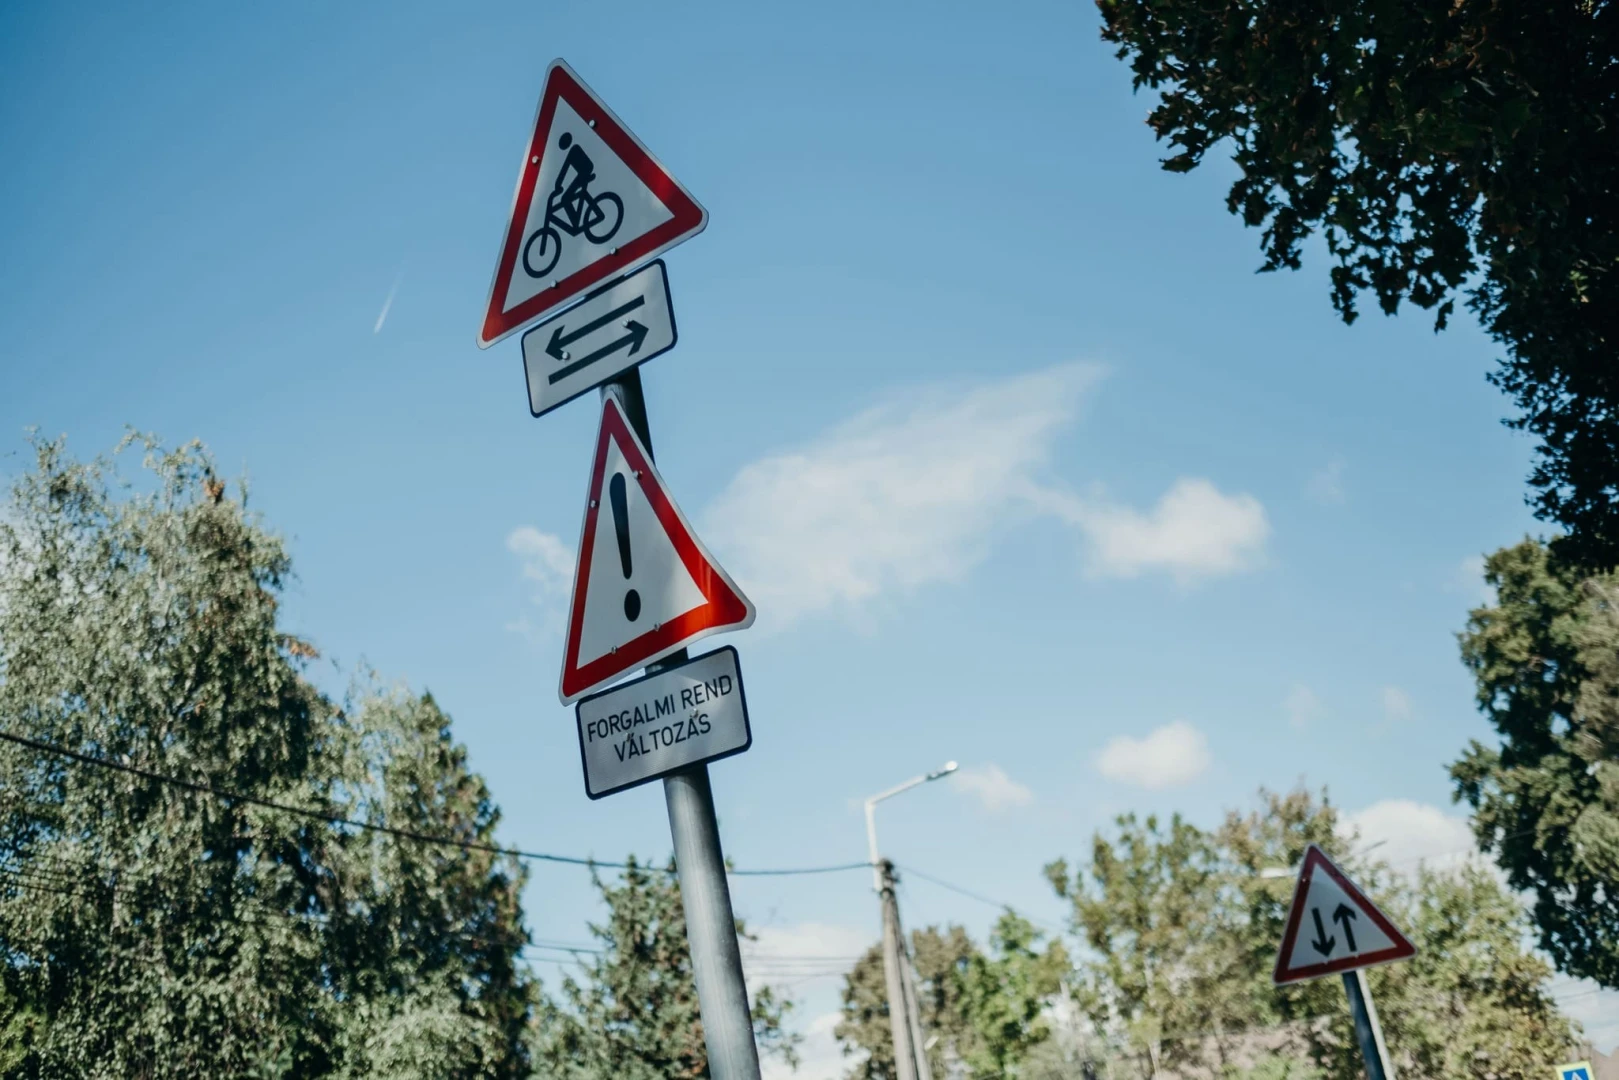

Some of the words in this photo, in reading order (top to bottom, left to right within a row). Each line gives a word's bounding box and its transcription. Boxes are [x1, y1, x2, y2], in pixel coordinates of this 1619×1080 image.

[587, 694, 675, 742] FORGALMI
[681, 675, 732, 709] REND
[614, 713, 711, 762] VÁLTOZÁS
